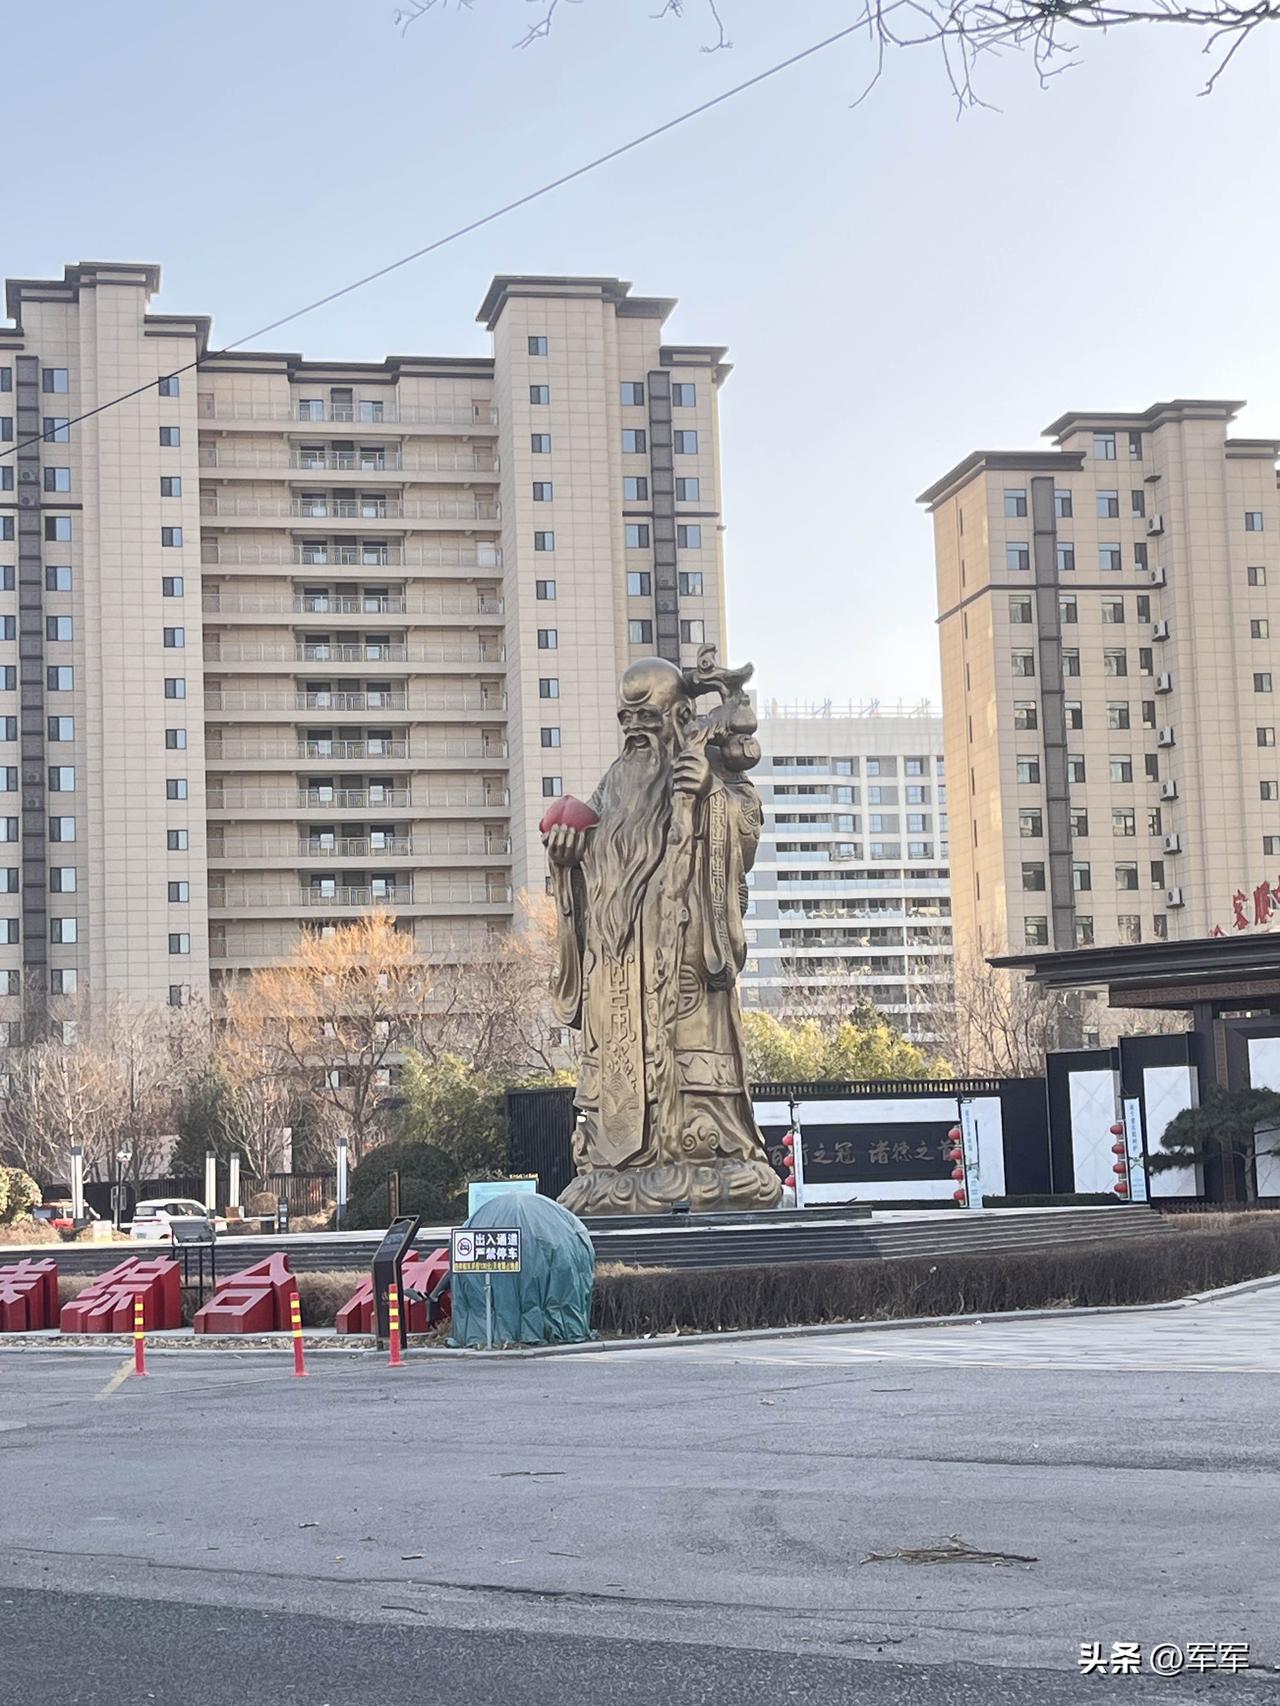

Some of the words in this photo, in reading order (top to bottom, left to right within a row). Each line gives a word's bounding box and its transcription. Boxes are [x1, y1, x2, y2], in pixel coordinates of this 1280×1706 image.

[475, 1233, 518, 1246] 出入通道
[475, 1247, 518, 1260] 严禁停车
